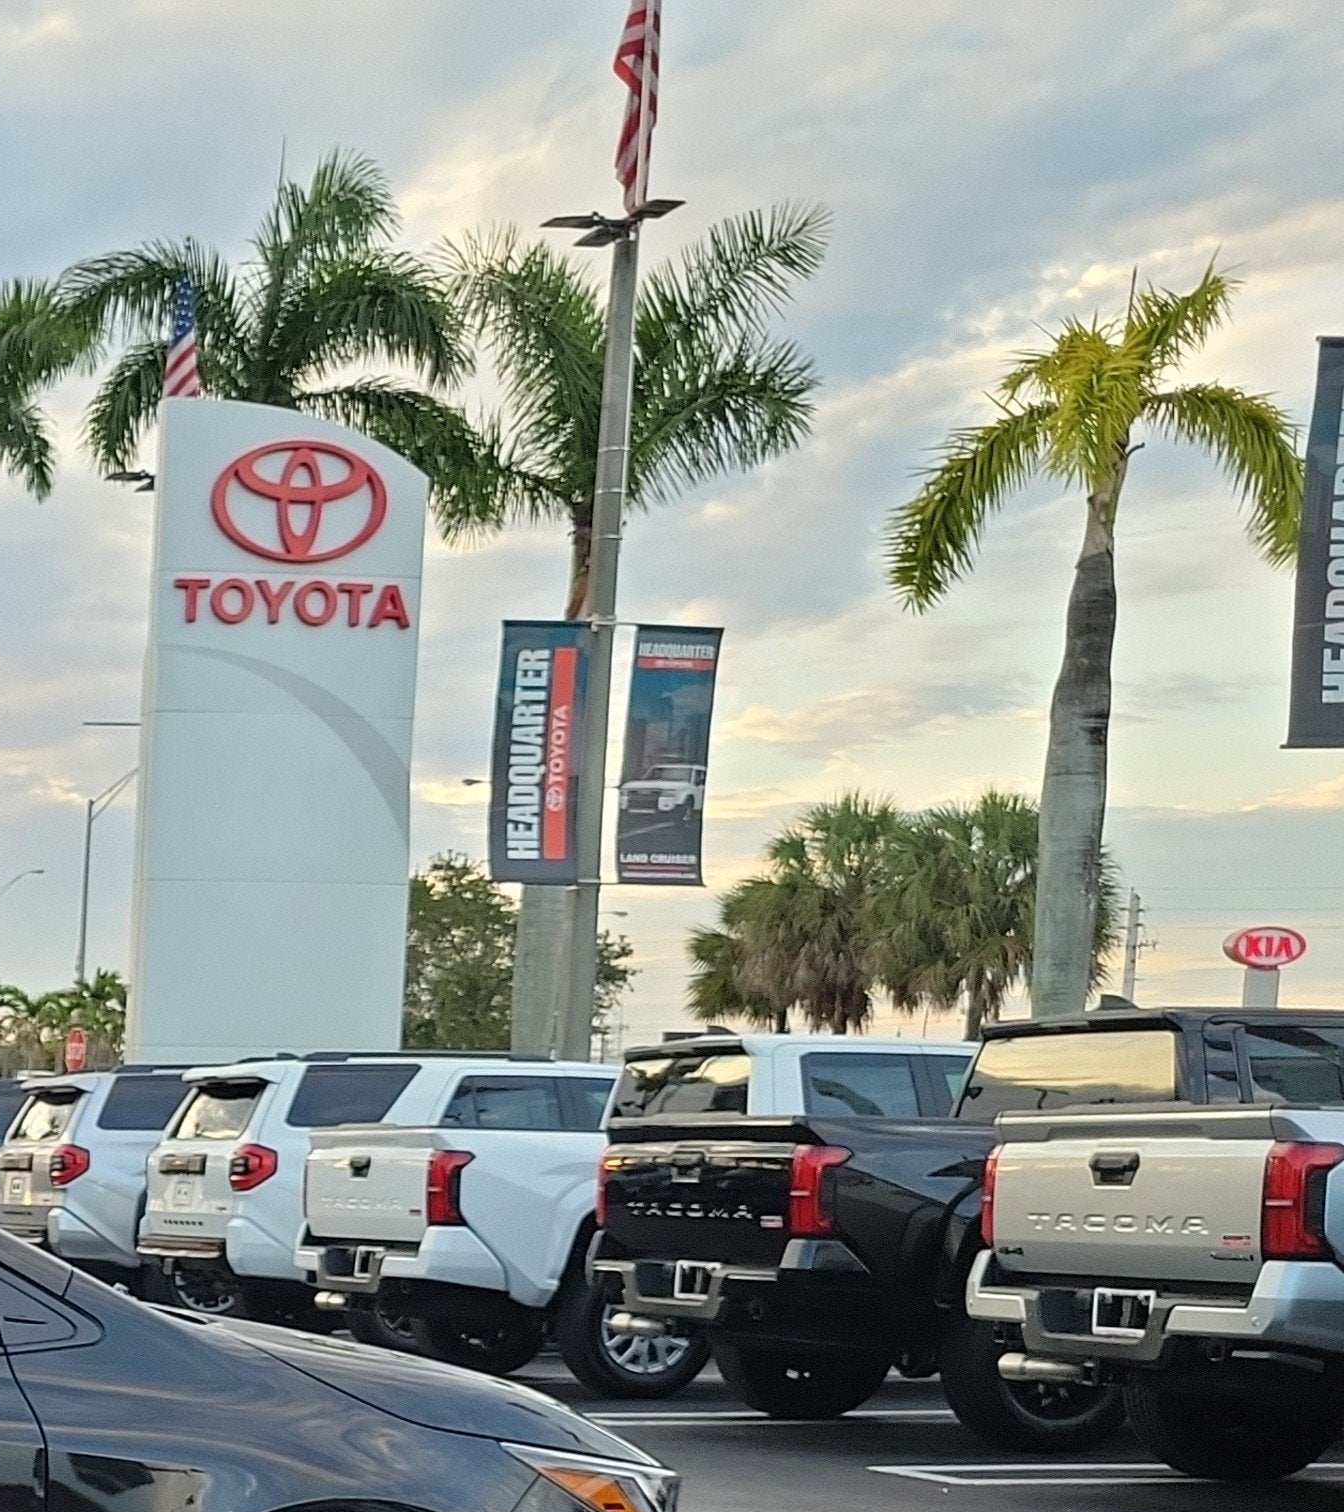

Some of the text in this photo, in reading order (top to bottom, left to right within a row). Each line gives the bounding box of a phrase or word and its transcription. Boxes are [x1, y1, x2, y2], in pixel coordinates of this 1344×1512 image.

[173, 577, 410, 630] TOYOTA
[506, 648, 551, 860] HEADQUARTER
[548, 704, 571, 784] TOYOTA
[1244, 935, 1294, 960] KIA
[626, 1202, 753, 1220] TACOMA
[1026, 1212, 1210, 1235] TACOMA
